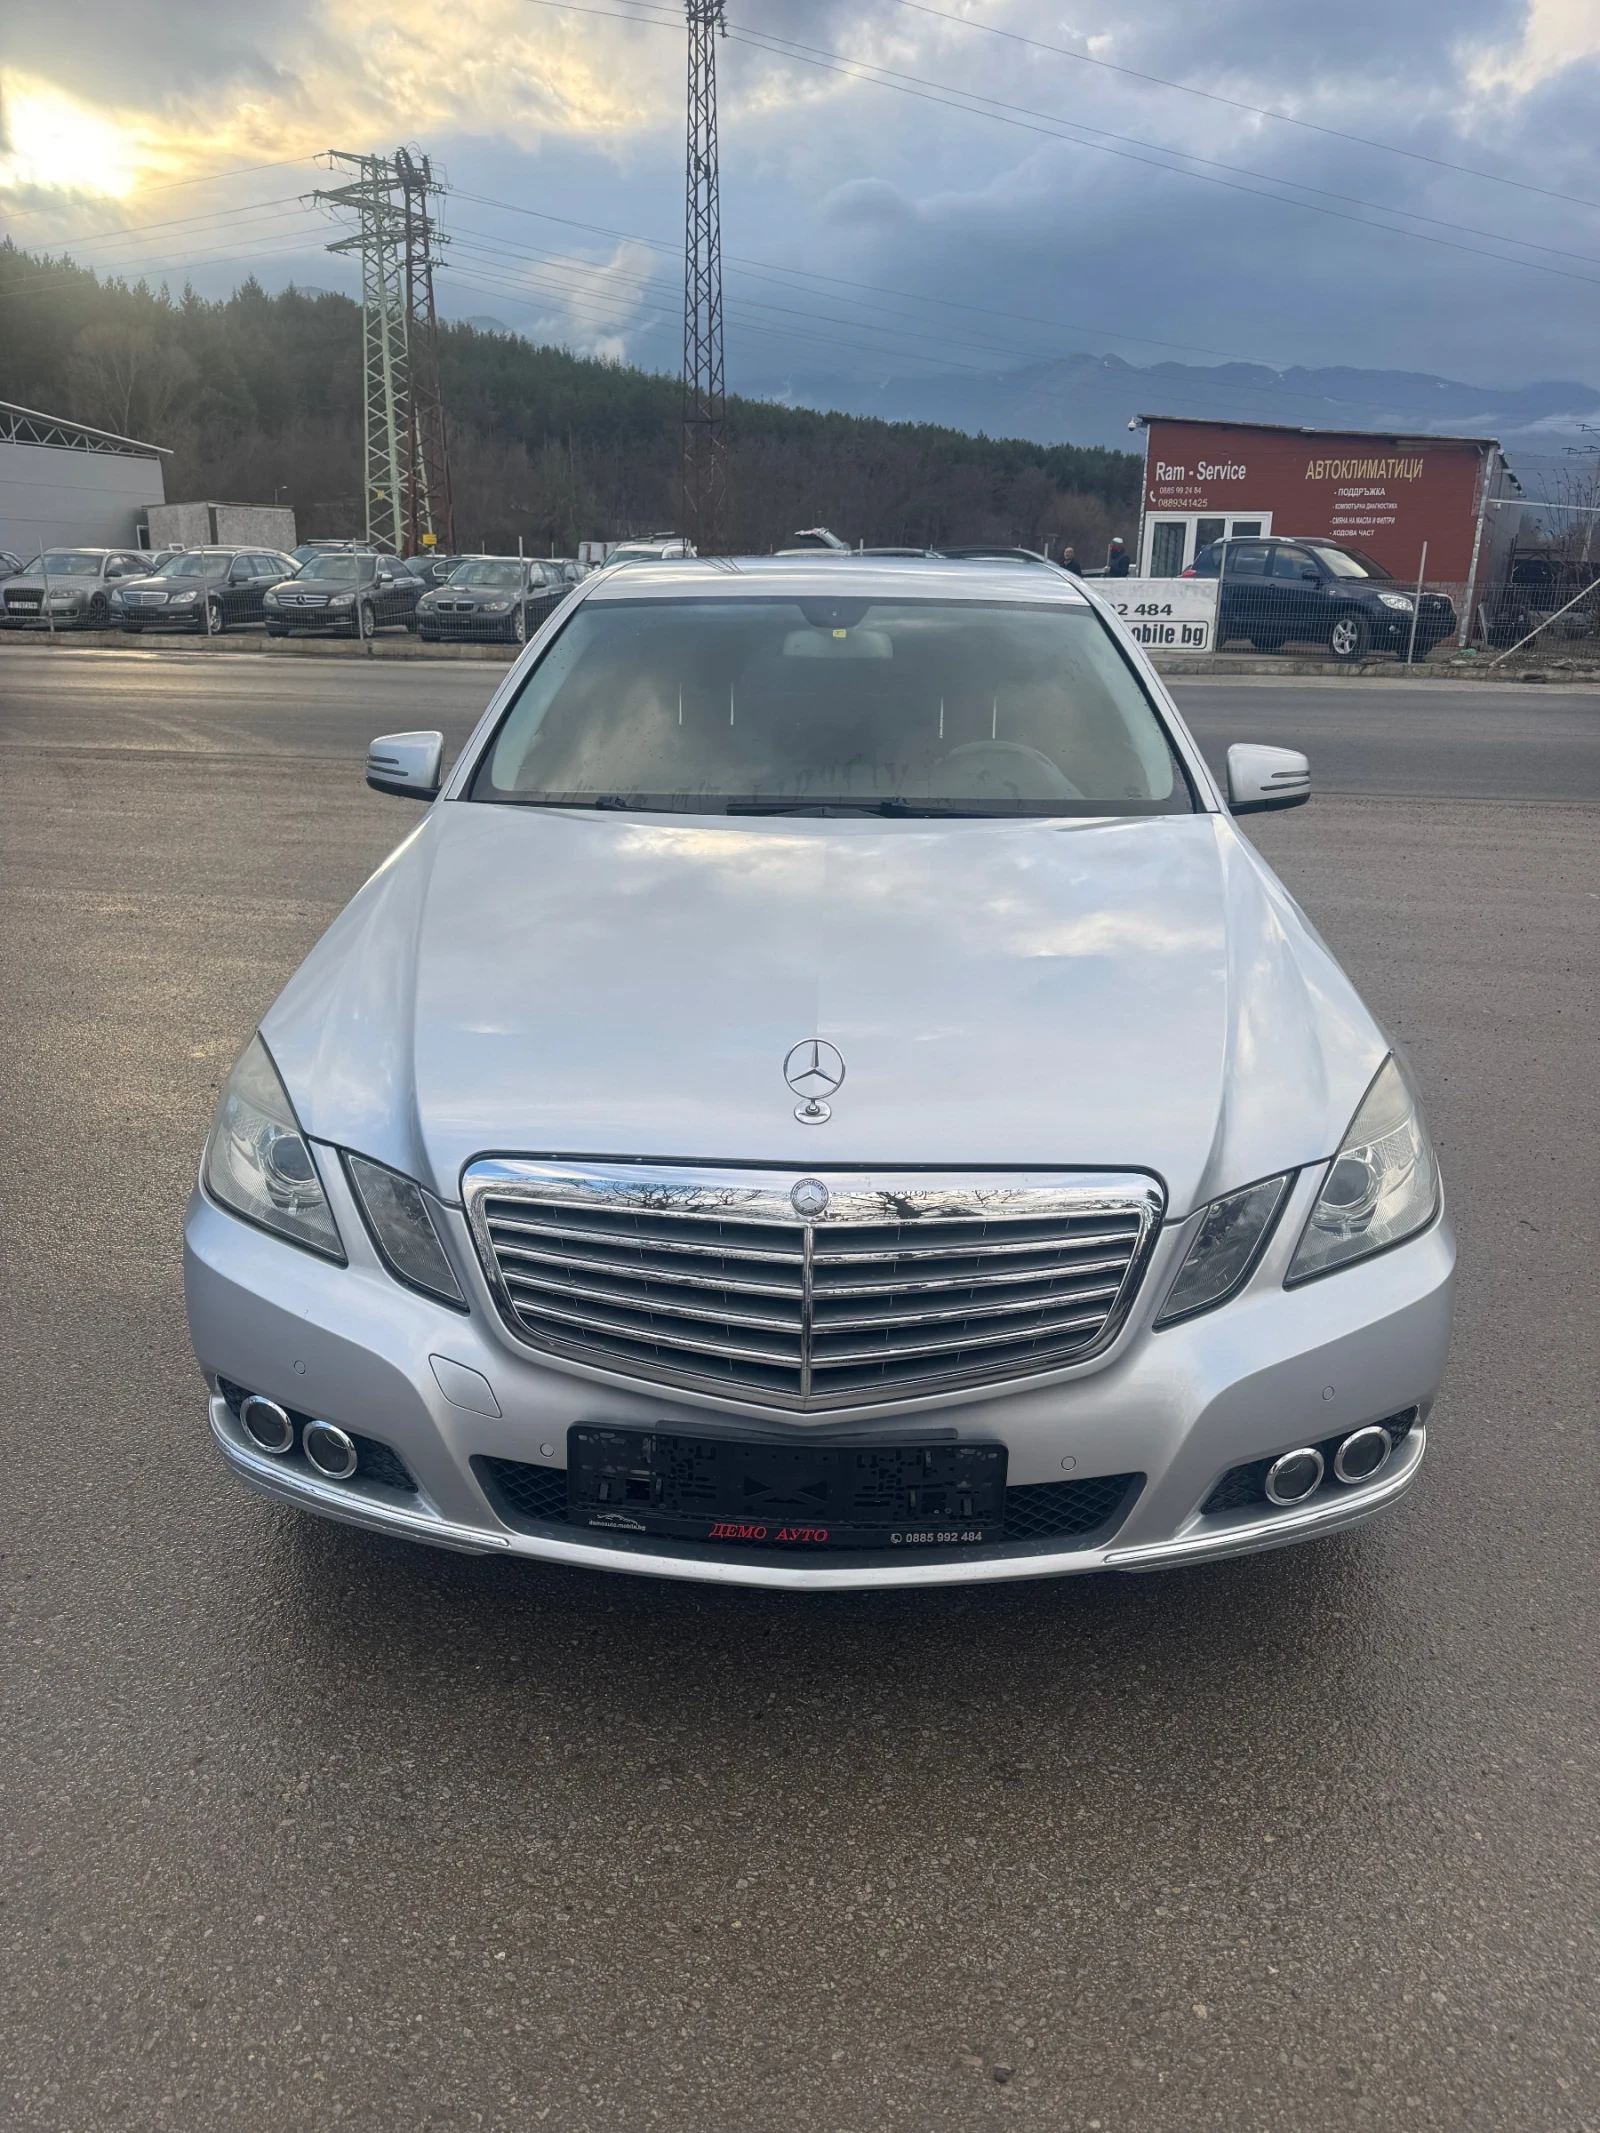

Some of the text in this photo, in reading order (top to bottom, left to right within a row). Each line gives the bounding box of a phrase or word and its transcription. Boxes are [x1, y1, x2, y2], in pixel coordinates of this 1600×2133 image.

[1155, 461, 1185, 481] Ram
[1197, 460, 1246, 480] Service
[1305, 458, 1424, 482] АВТОКЛИМАТИЦИ
[1338, 488, 1386, 497] ПОДДРЪЖКА
[1134, 604, 1173, 615] 484
[708, 1523, 828, 1541] ДЕМО АУТО
[906, 1531, 982, 1543] 0885 992 484
